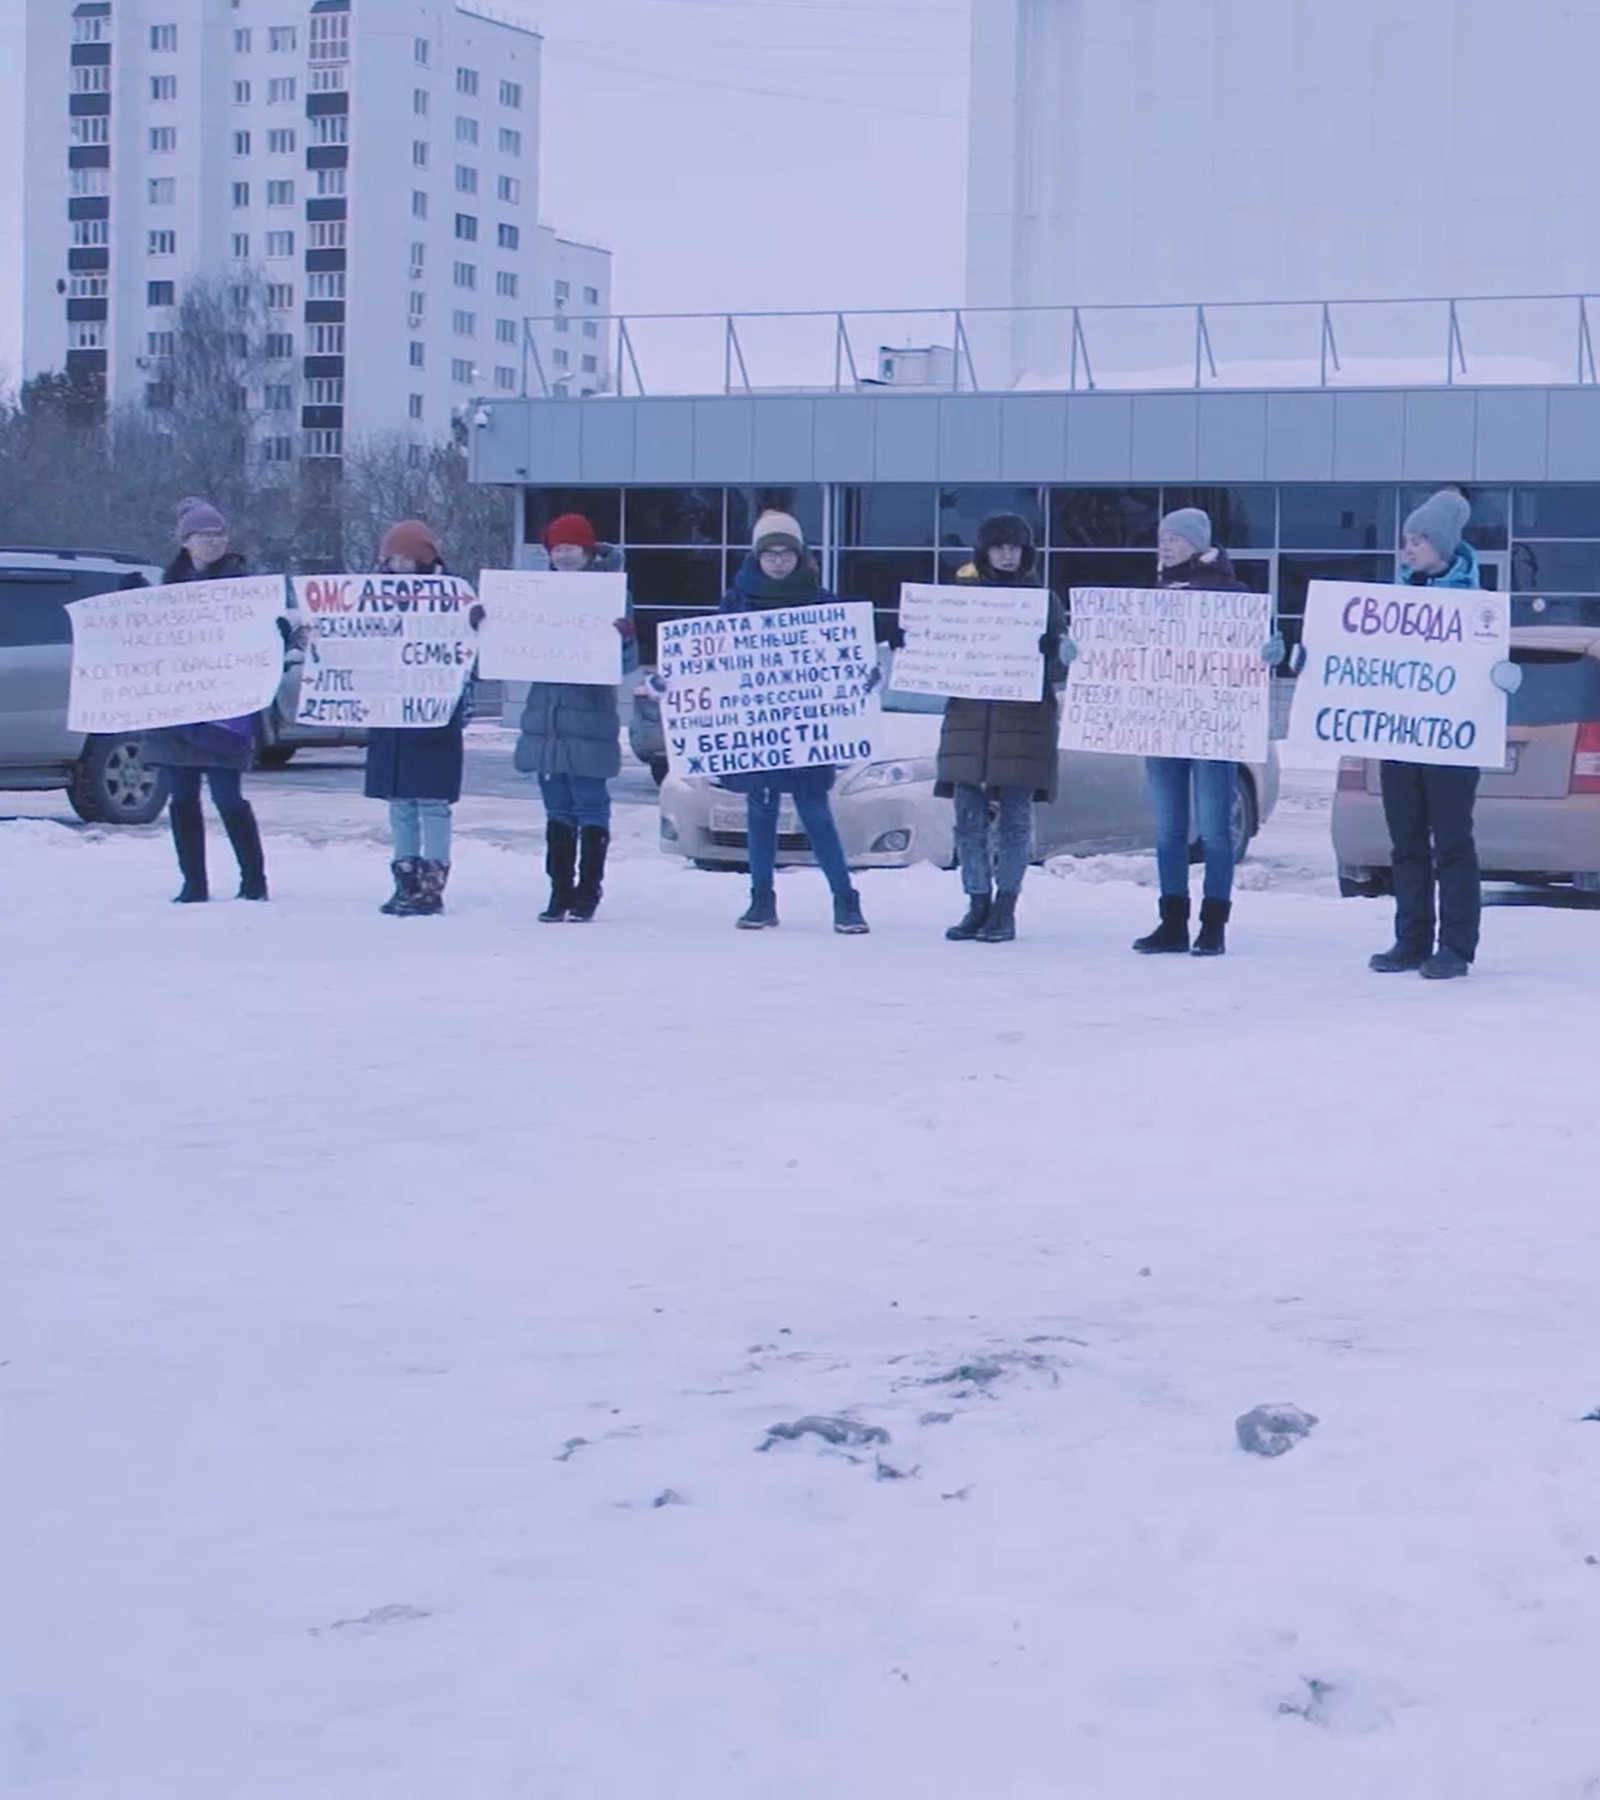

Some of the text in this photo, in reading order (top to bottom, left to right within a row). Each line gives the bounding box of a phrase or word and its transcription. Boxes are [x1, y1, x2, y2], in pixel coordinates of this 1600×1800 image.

[305, 580, 460, 613] ОМС АБОРТЫ
[662, 618, 752, 641] ЗАРПЛАТА
[1072, 617, 1091, 643] ОТ
[1093, 617, 1187, 646] ДОМАШНЕГО
[1342, 596, 1463, 643] СВОБОДА
[401, 642, 465, 665] СЕМЬЕ
[662, 643, 683, 658] НА
[690, 636, 725, 658] 30%
[819, 626, 857, 643] ЧЕМ
[661, 645, 864, 679] У МУЖЧИН НА ТЕХ ЖЕ
[738, 662, 870, 689] ДОЛЖНОСТЯХ
[1151, 648, 1196, 687] ОДНА
[1323, 654, 1457, 696] РАВЕНСТВО
[667, 687, 712, 714] 456
[719, 684, 824, 709] ПРОФЕССИЙ
[832, 682, 873, 700] ДЛЯ
[1069, 704, 1082, 724] О
[1210, 689, 1261, 713] ЗАКОН
[672, 723, 830, 756] У БЕДНОСТИ
[1315, 706, 1477, 751] СЕСТРИНСТВО
[687, 740, 872, 774] ЖЕНСКОЕ ЛИЦО
